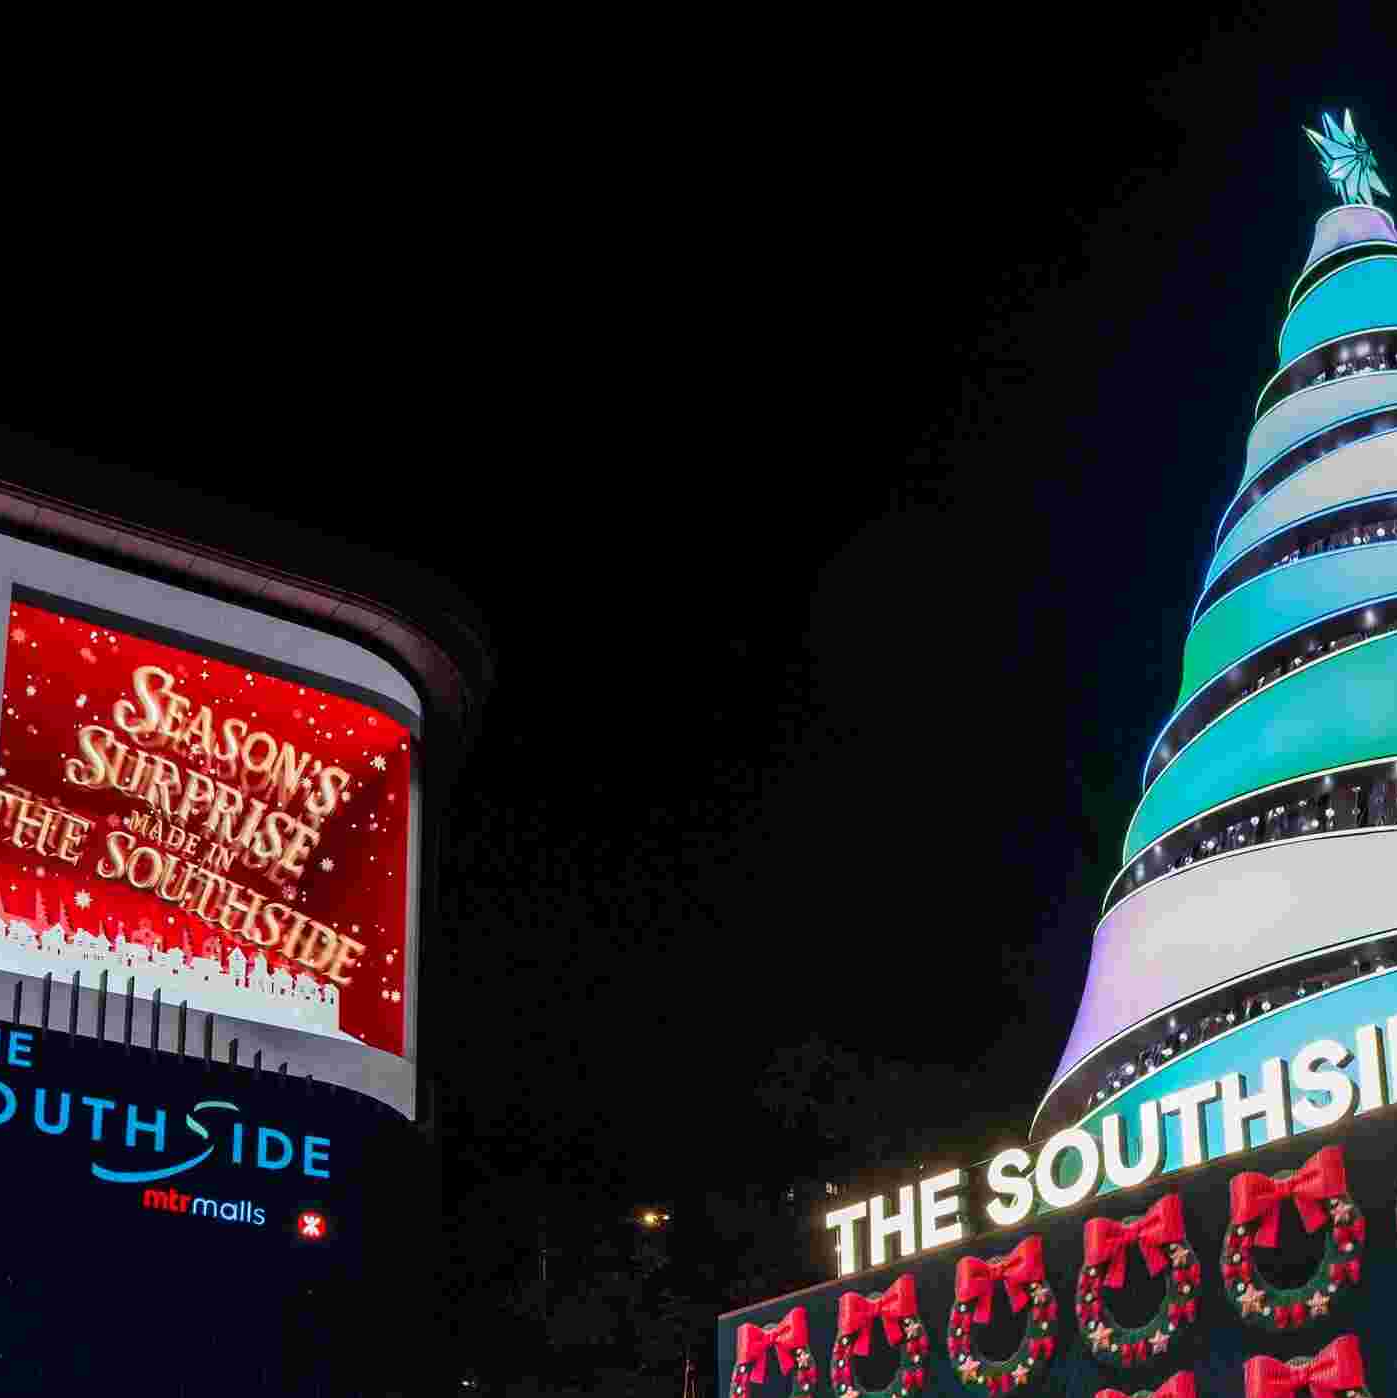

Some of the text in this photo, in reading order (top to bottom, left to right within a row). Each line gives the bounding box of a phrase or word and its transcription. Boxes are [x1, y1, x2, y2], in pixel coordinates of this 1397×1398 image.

[65, 724, 321, 874] SURPRISE
[113, 665, 352, 818] SEASON'S
[128, 810, 240, 873] MADE IN
[96, 831, 366, 986] SOUTHSIDE
[142, 1186, 266, 1226] mtrmalls
[825, 1168, 964, 1277] THE
